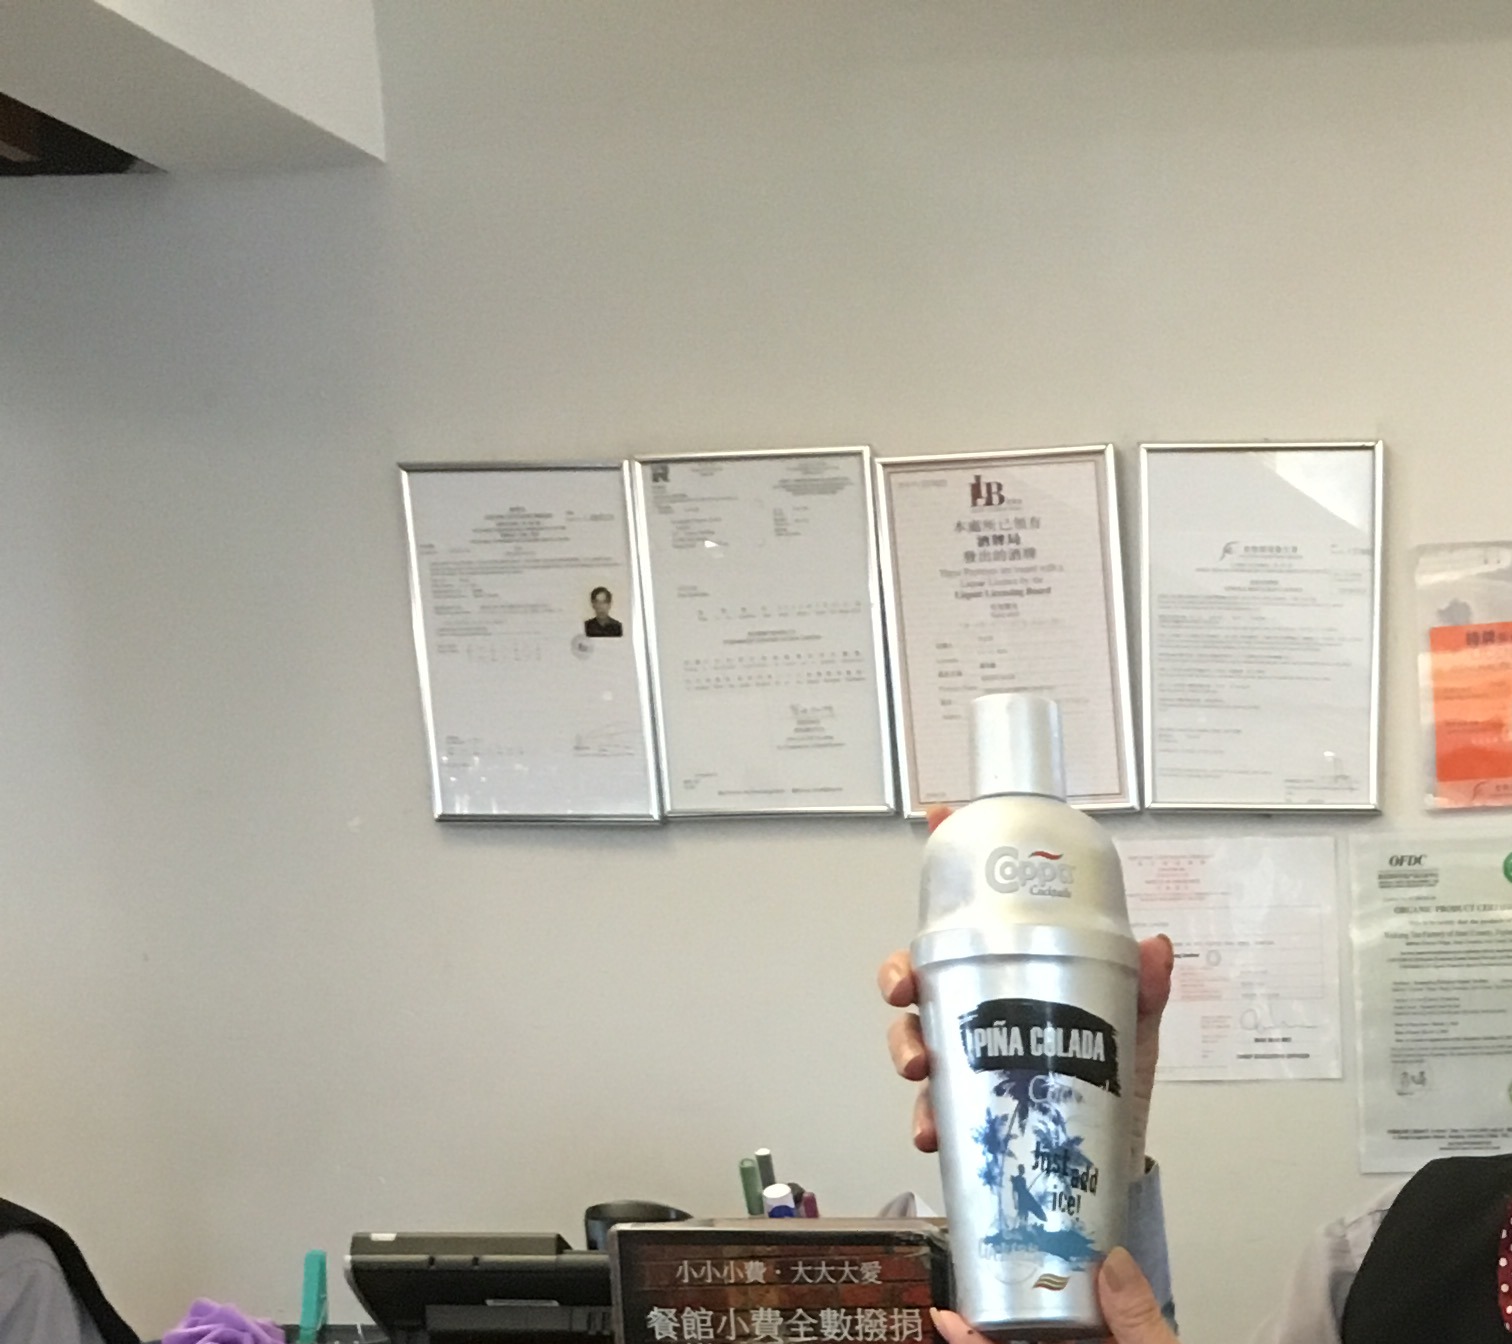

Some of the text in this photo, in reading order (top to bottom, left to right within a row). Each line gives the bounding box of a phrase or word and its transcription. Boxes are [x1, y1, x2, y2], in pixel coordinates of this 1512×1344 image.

[985, 846, 1077, 893] Coppa
[1389, 855, 1428, 867] OFDC
[973, 1020, 1106, 1062] PIÑA COLADA
[1032, 1141, 1099, 1197] Just add
[1052, 1184, 1082, 1222] ice!
[646, 1305, 924, 1342] 餐館小費全數撥捐
